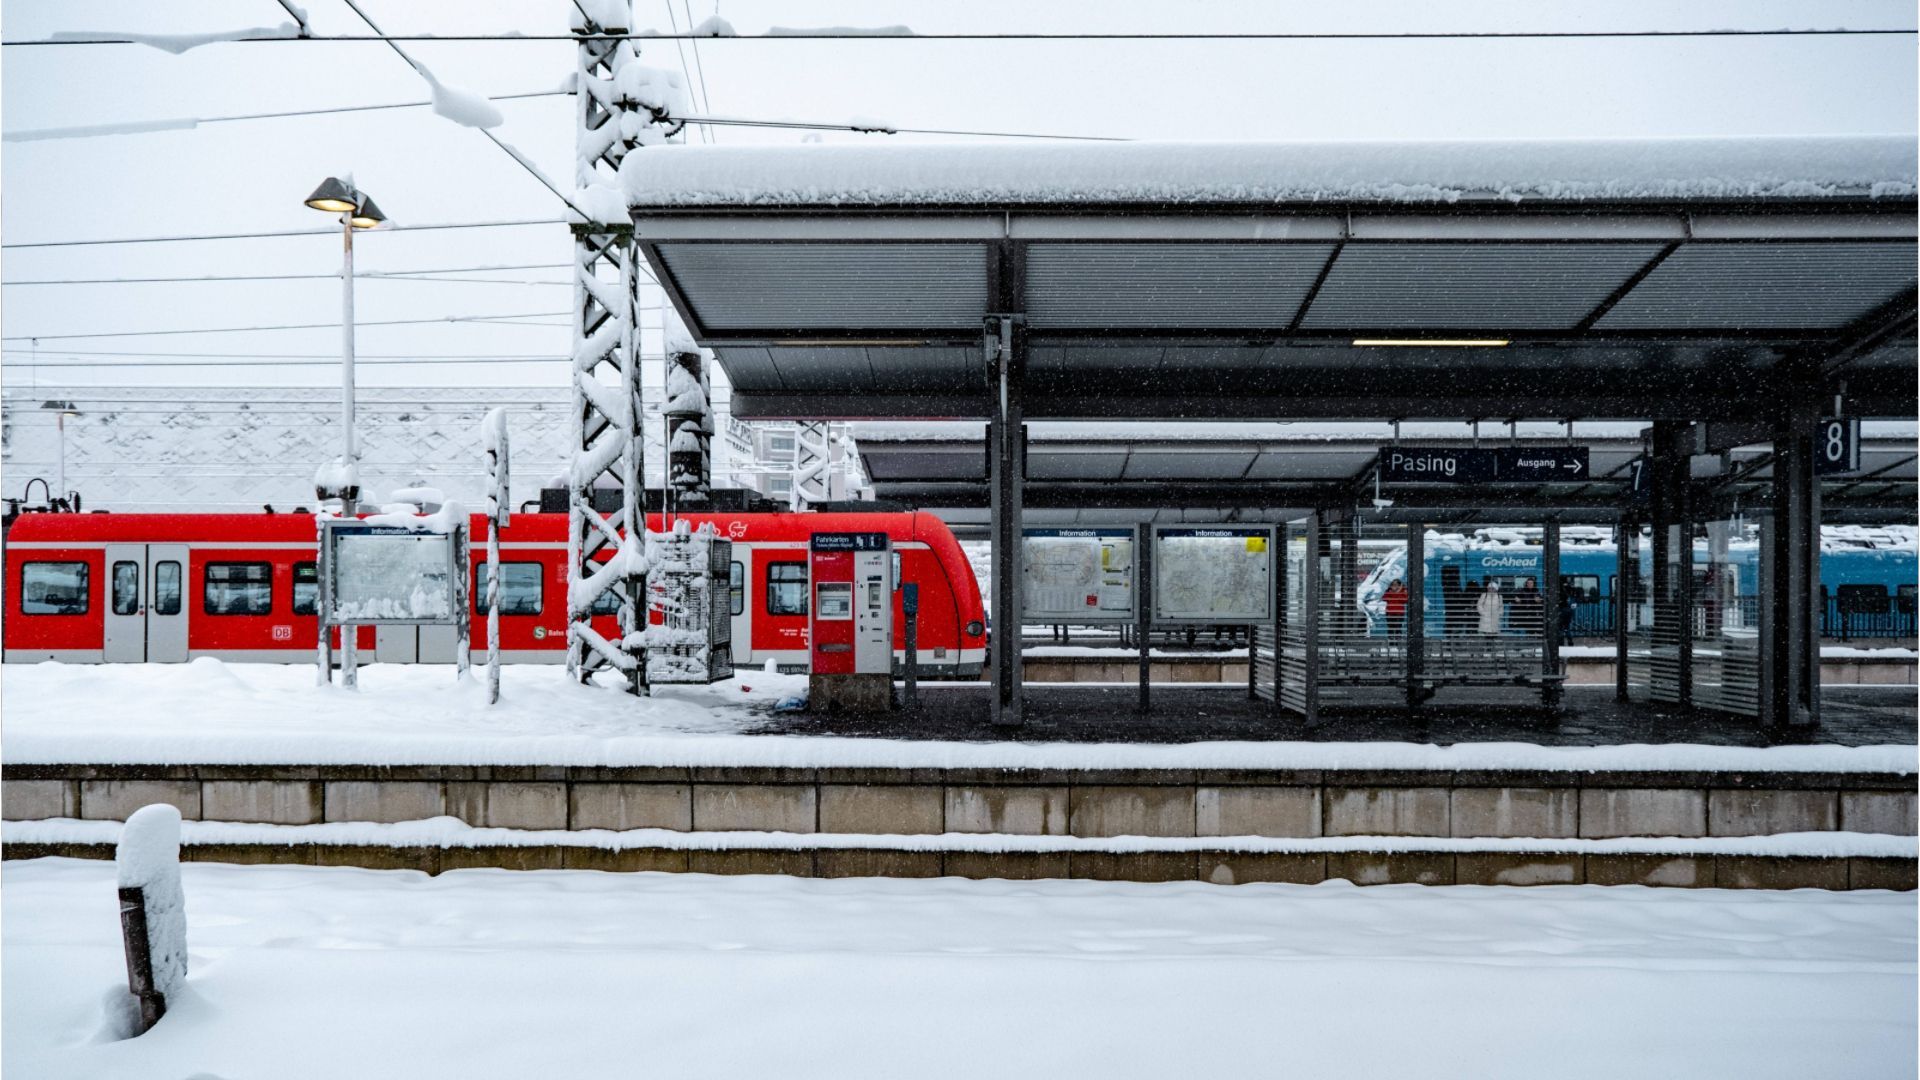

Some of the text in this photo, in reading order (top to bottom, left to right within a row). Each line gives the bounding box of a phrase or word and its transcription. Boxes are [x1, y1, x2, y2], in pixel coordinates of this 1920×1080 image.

[1826, 422, 1843, 461] 8
[1391, 454, 1456, 476] Pasing
[1517, 458, 1555, 469] Ausgang
[1632, 460, 1643, 491] 7
[815, 535, 849, 543] Fahrkarten
[1481, 556, 1538, 567] Go-Ahead
[275, 627, 290, 638] DB
